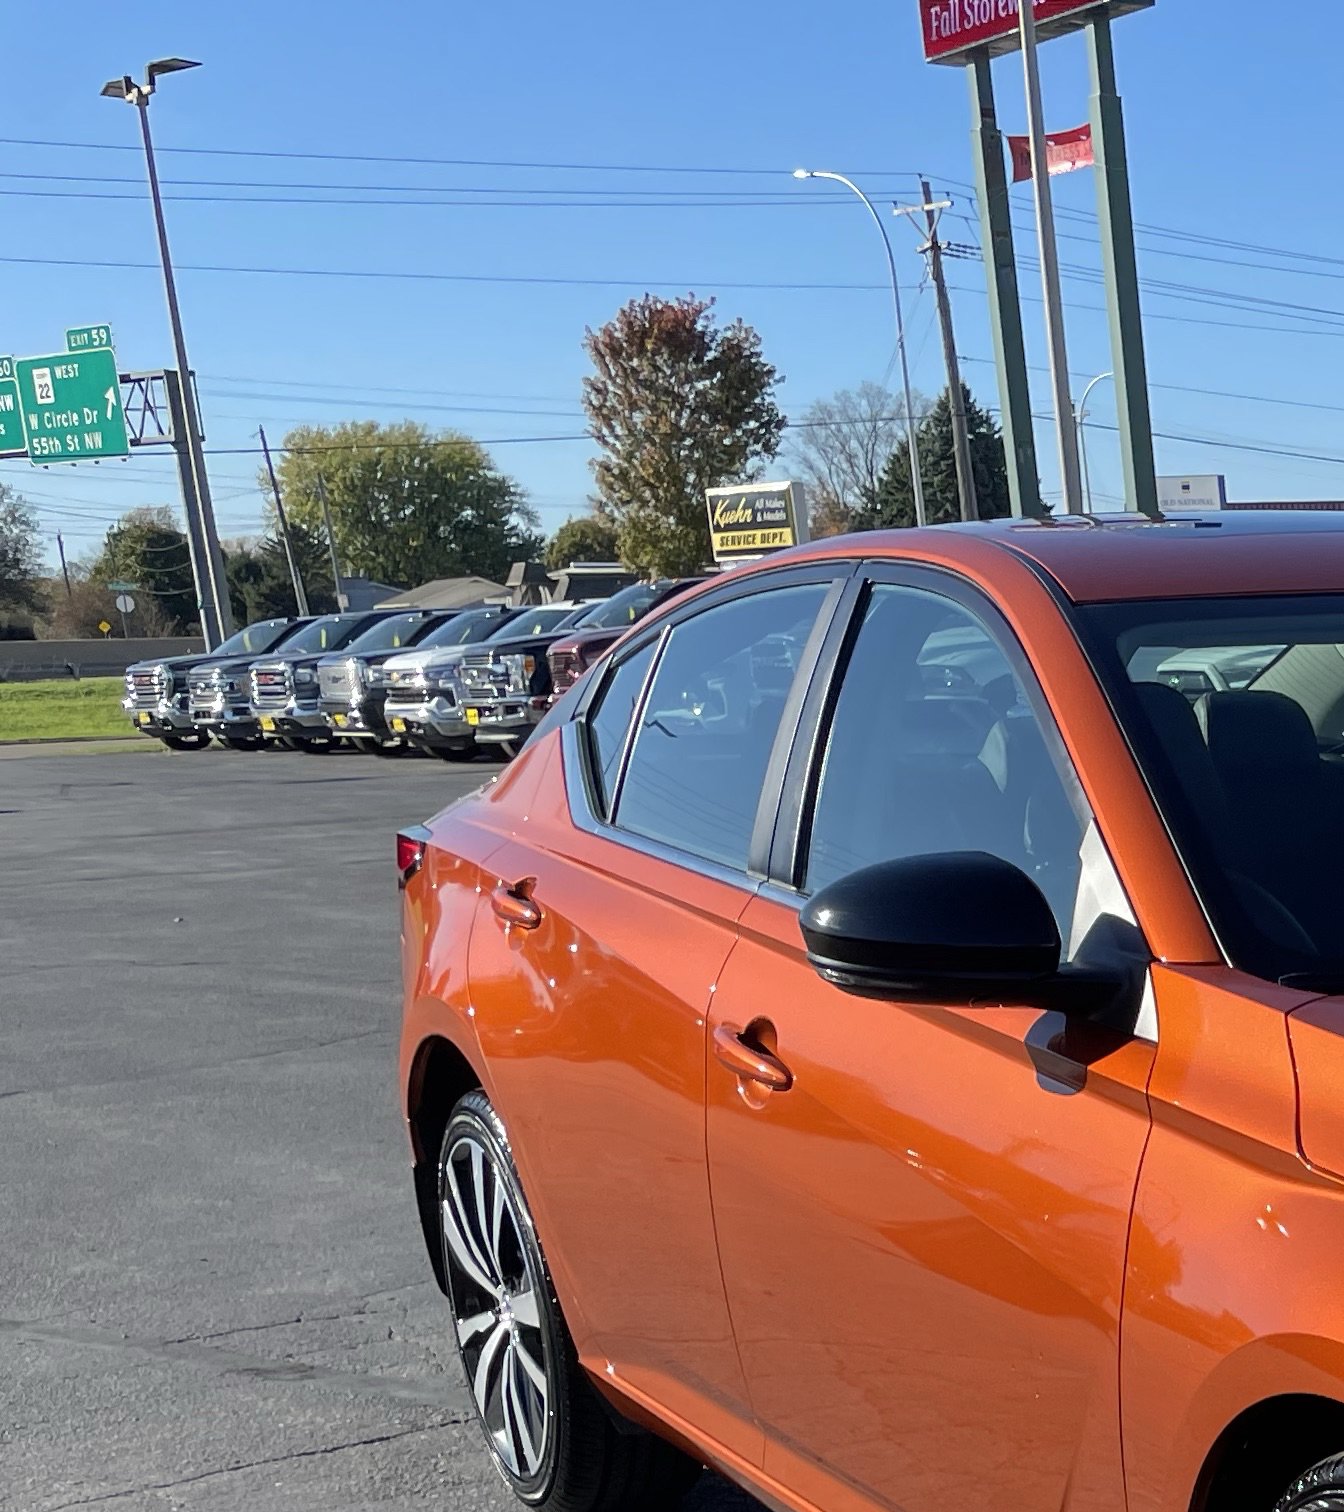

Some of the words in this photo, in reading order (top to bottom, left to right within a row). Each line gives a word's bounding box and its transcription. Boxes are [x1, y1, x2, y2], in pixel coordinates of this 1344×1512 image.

[929, 0, 961, 41] Fall
[70, 333, 89, 347] EXIT
[91, 328, 107, 346] 59
[54, 364, 79, 380] WEST
[38, 383, 52, 400] 22
[28, 413, 39, 430] W
[43, 409, 79, 429] Circle
[83, 407, 99, 425] Dr
[32, 436, 62, 455] 55th
[66, 434, 80, 451] St
[84, 431, 103, 449] NW
[713, 497, 753, 528] Kuehn
[720, 533, 757, 547] SERVICE
[760, 531, 787, 544] DEPT.
